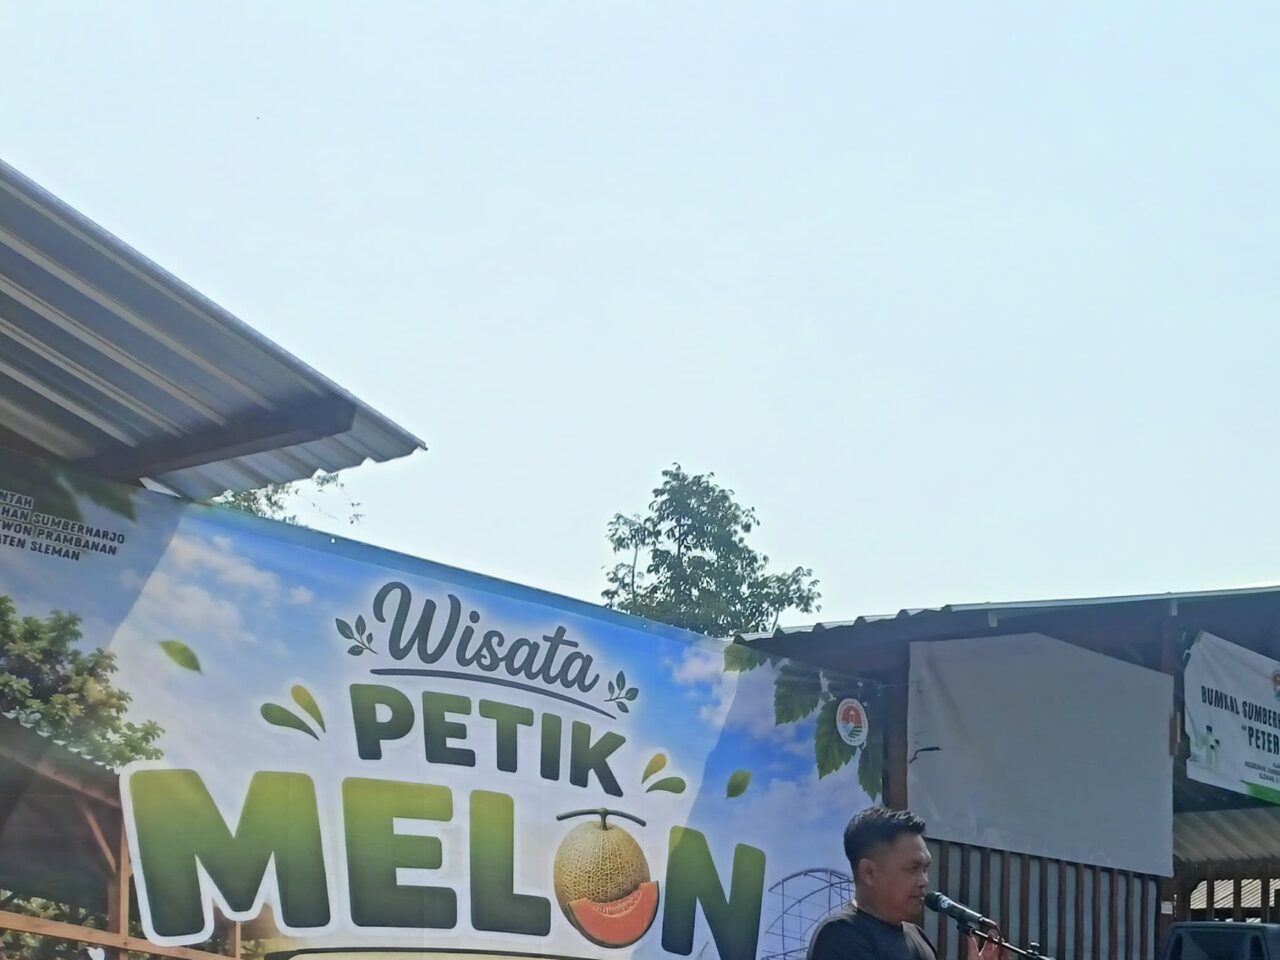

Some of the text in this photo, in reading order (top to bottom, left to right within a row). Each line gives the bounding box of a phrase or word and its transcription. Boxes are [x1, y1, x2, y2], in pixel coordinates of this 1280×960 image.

[32, 513, 125, 544] SUMBERHARJO
[37, 528, 117, 556] PRAMBANAN
[30, 541, 80, 561] SLEMAN
[373, 581, 600, 693] Wisata
[1201, 685, 1240, 716] BUMKAL
[349, 683, 627, 797] PETIK
